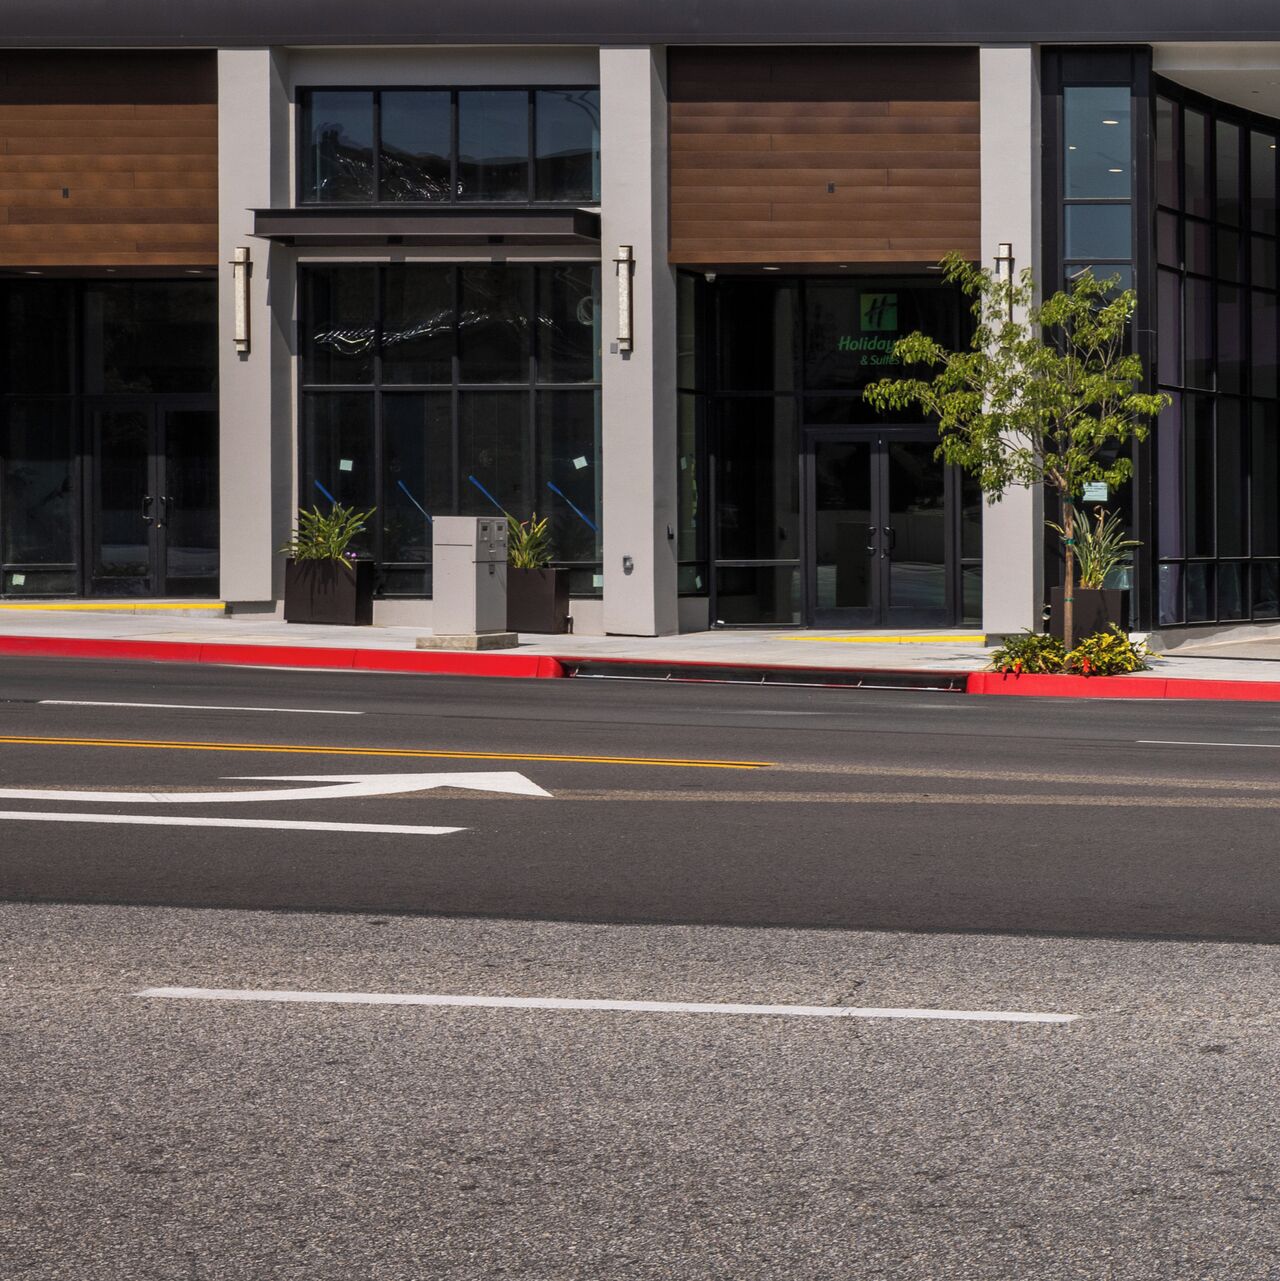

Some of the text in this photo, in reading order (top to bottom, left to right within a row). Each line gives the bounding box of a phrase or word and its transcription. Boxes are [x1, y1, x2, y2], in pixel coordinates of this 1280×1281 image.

[838, 335, 895, 354] Holiday
[860, 354, 901, 366] & Suites
